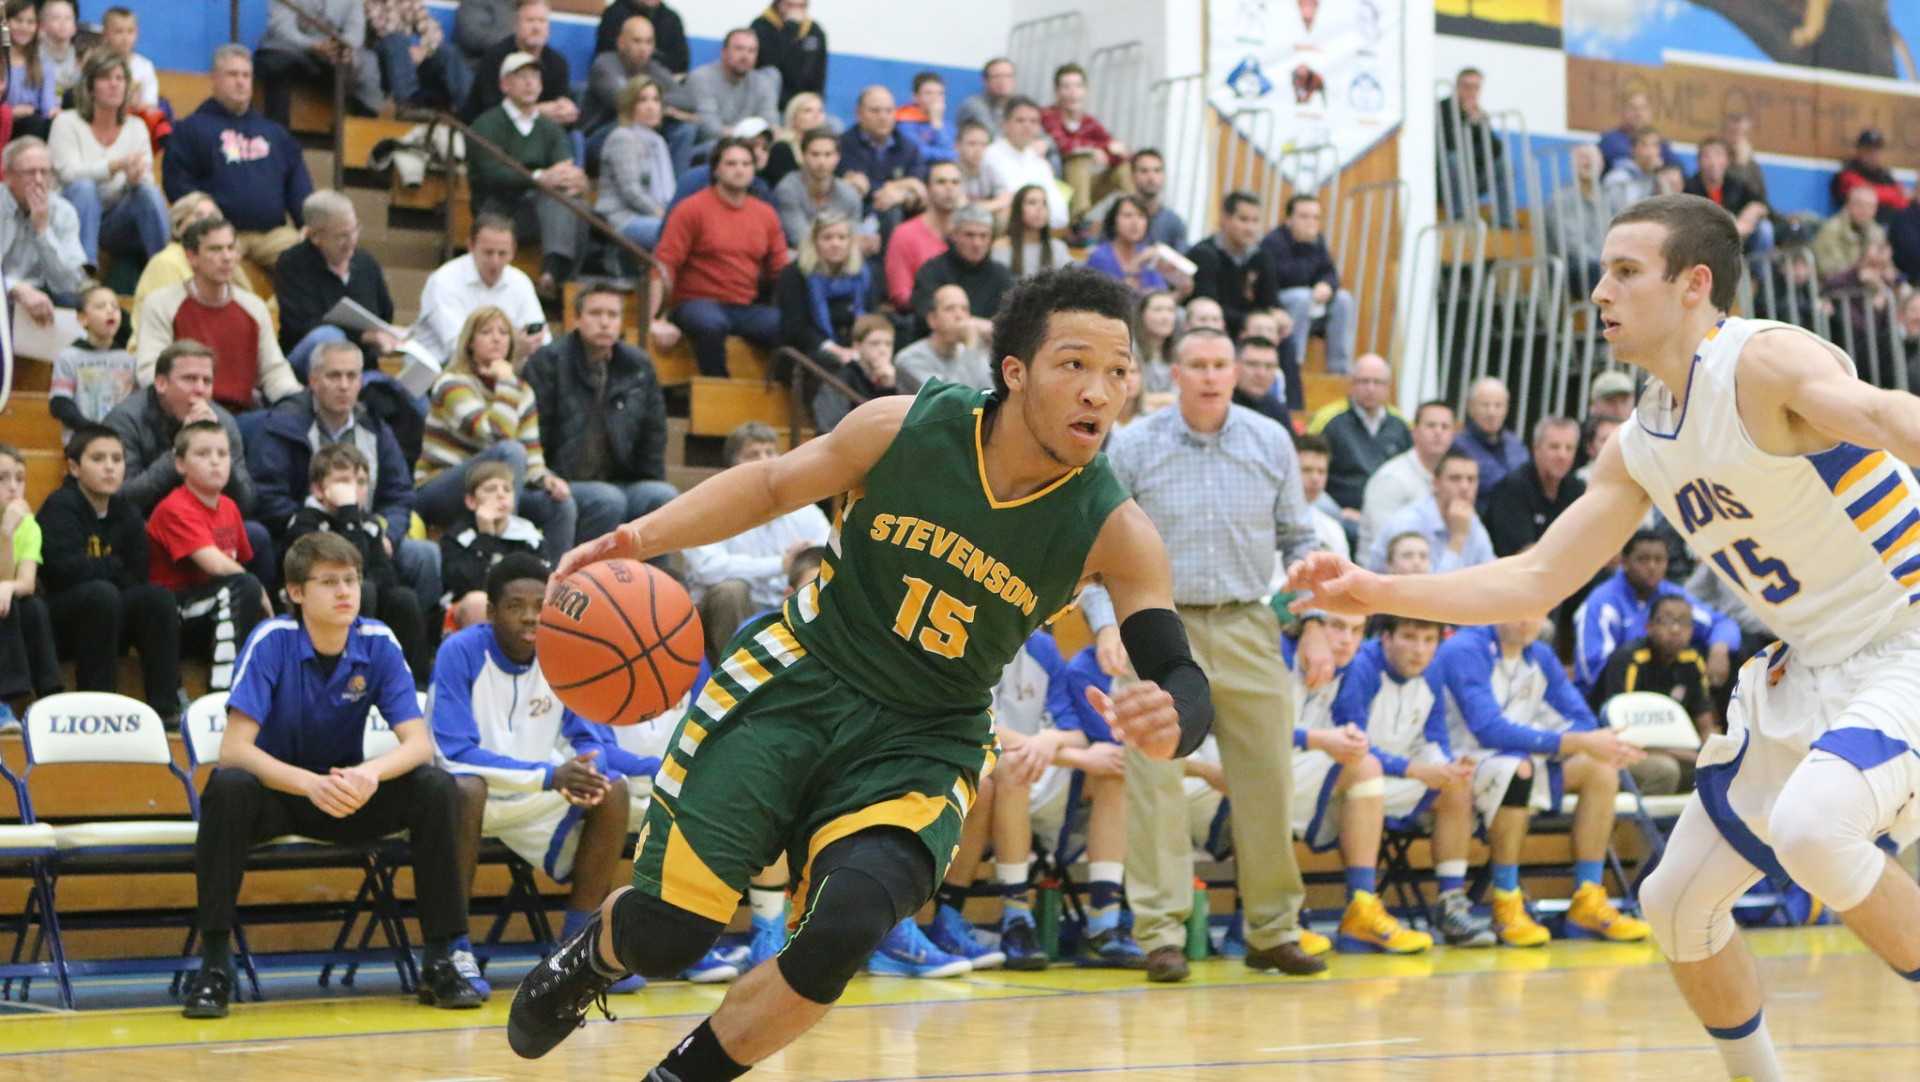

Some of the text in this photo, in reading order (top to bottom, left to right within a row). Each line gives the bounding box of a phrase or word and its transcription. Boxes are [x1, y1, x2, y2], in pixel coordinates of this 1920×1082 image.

[870, 513, 1039, 616] STEVENSON
[892, 574, 977, 659] 15
[49, 714, 141, 735] LIONS
